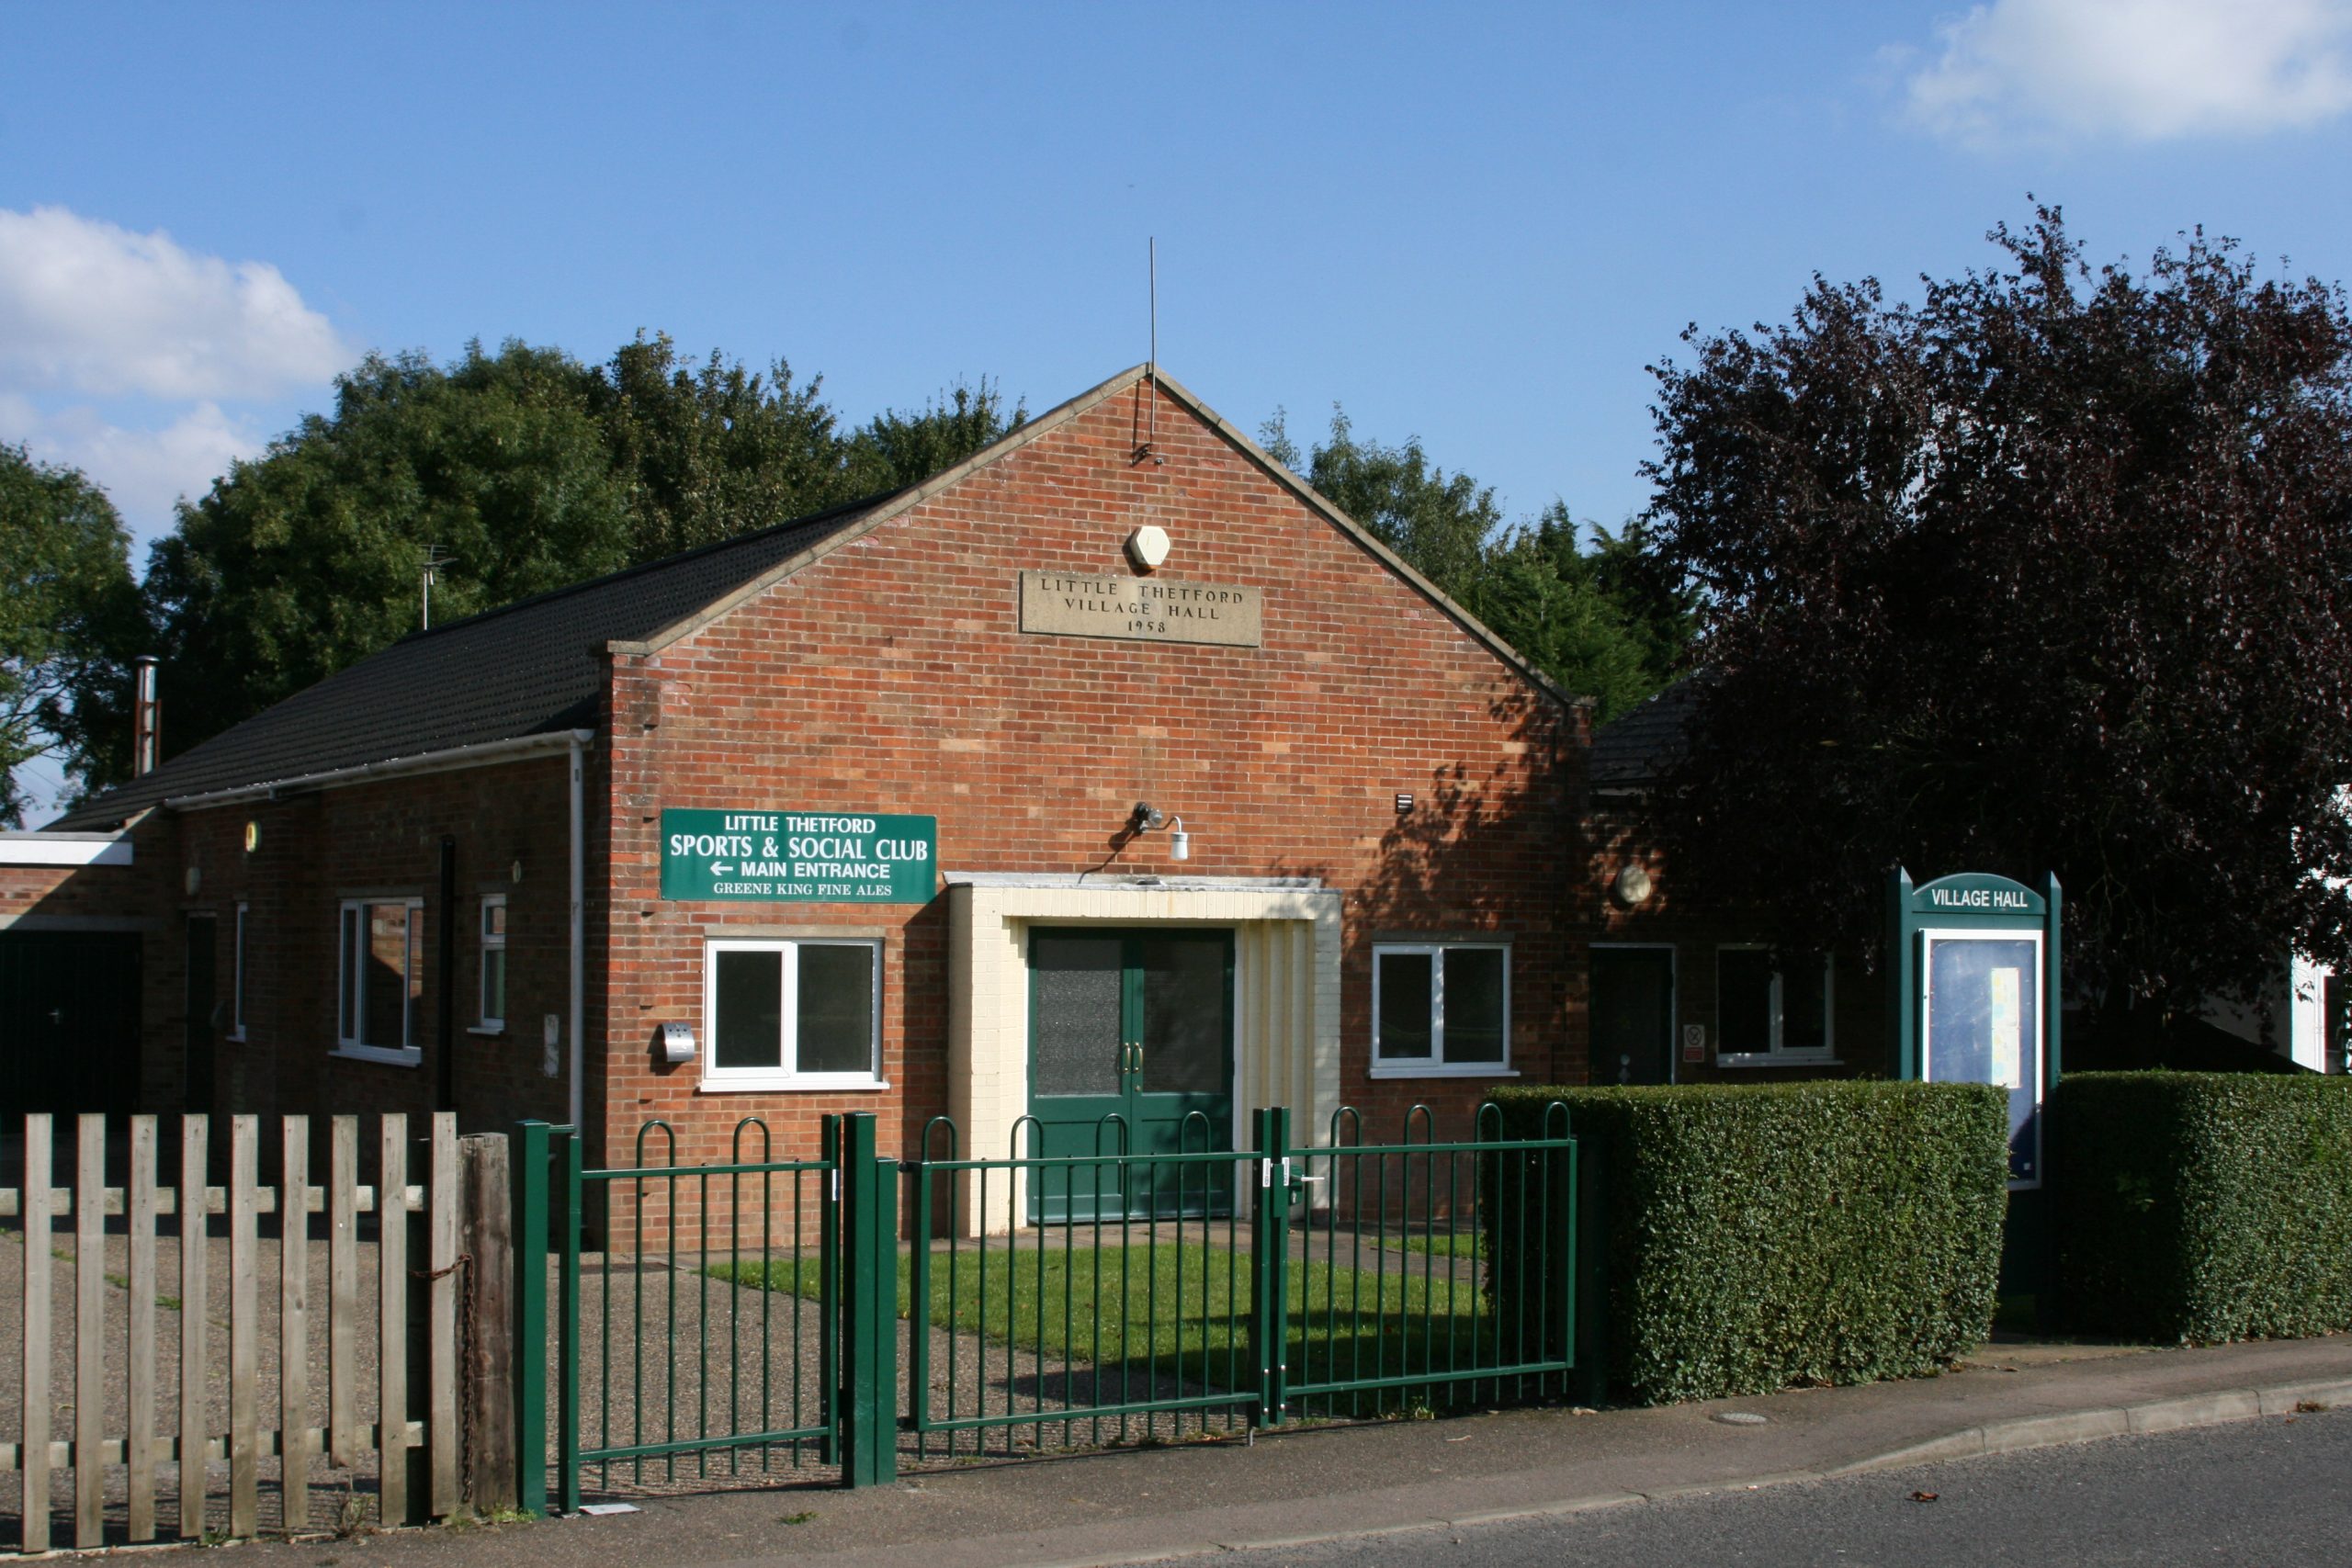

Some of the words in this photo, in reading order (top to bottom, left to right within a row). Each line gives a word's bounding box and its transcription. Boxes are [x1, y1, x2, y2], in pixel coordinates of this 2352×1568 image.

[1041, 579, 1117, 595] LITTLE
[1138, 585, 1243, 604] THETFORD
[1065, 598, 1150, 615] VILLAGE
[1169, 605, 1219, 620] HALL
[1127, 620, 1166, 633] 1958
[725, 815, 778, 831] LITTLE
[786, 817, 876, 833] THETFORD
[670, 834, 752, 857] SPORTS
[762, 836, 779, 859] &
[788, 838, 866, 860] SOCIAL
[876, 840, 928, 861] CLUB
[741, 862, 787, 877] MAIN
[794, 863, 890, 879] ENTRANCE
[713, 882, 772, 895] GREENE
[776, 884, 813, 896] KING
[818, 885, 851, 896] FINE
[856, 885, 892, 897] ALES
[1931, 888, 1990, 907] VILLAGE
[1994, 890, 2029, 908] HALL
